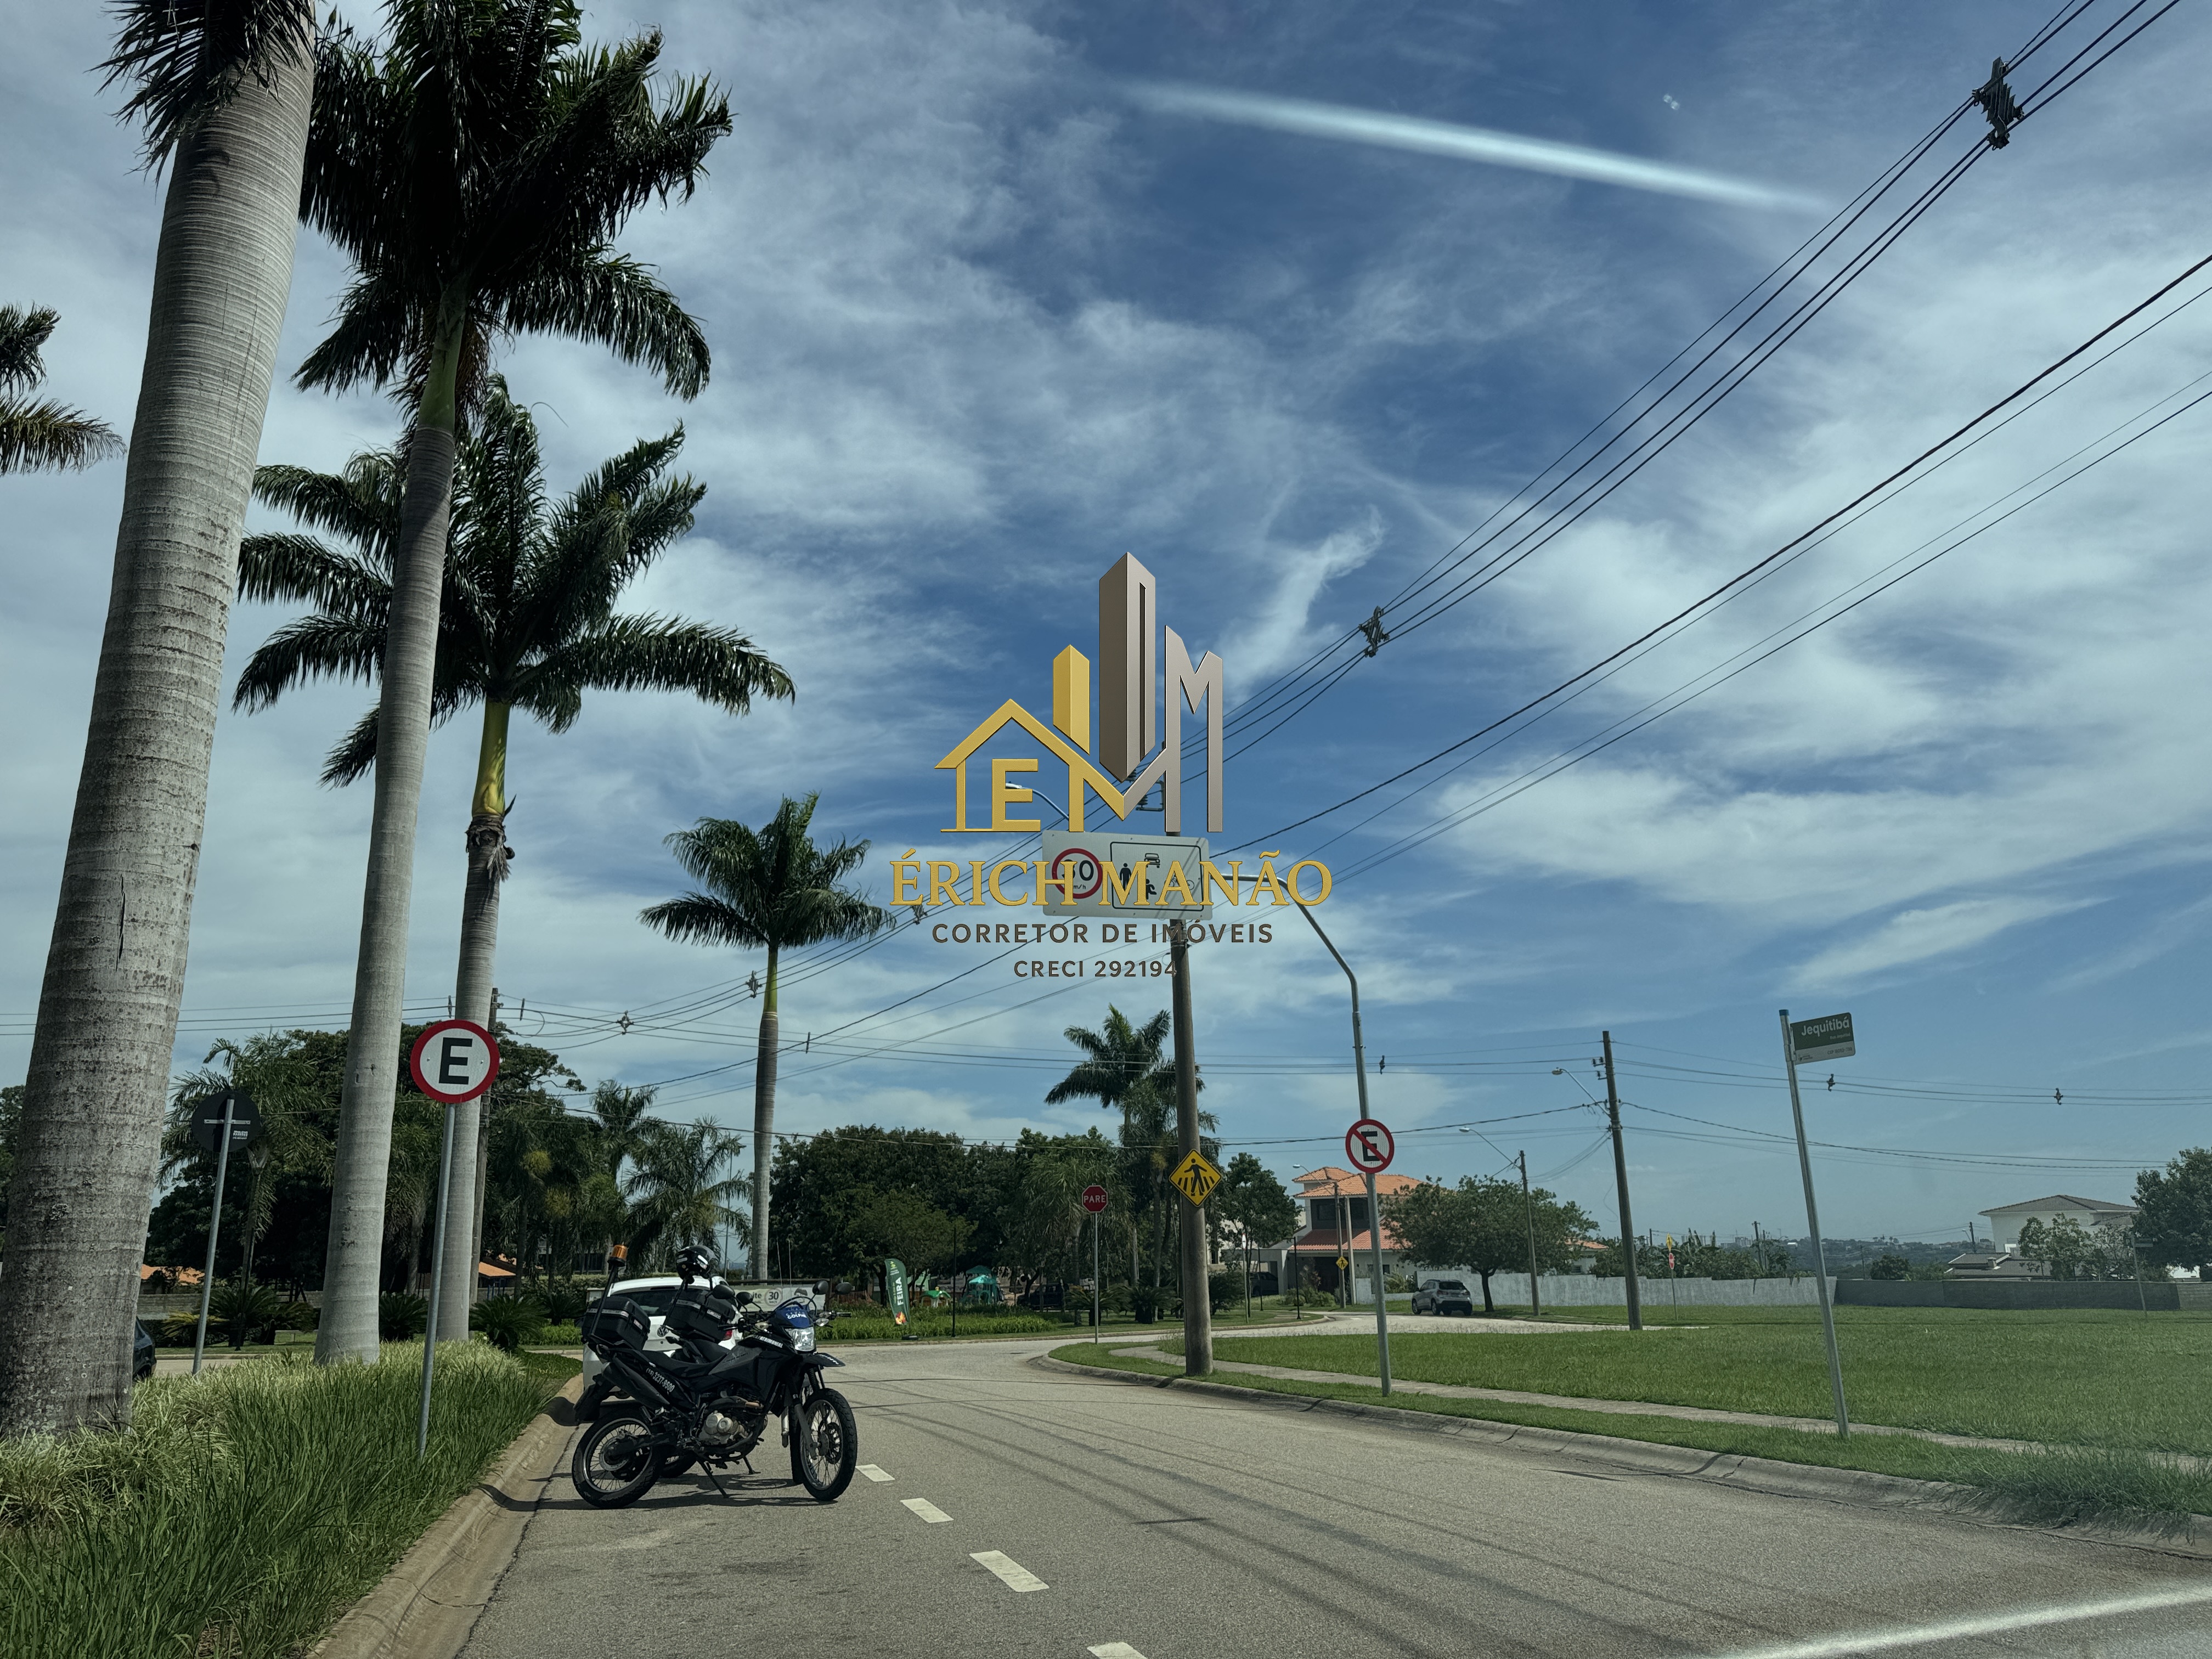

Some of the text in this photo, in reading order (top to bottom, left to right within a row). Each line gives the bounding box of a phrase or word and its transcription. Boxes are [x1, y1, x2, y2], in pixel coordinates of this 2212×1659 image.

[1801, 1015, 1850, 1037] Jequitibá
[439, 1037, 473, 1085] E
[1084, 1194, 1106, 1203] PARE
[768, 1291, 779, 1300] 30
